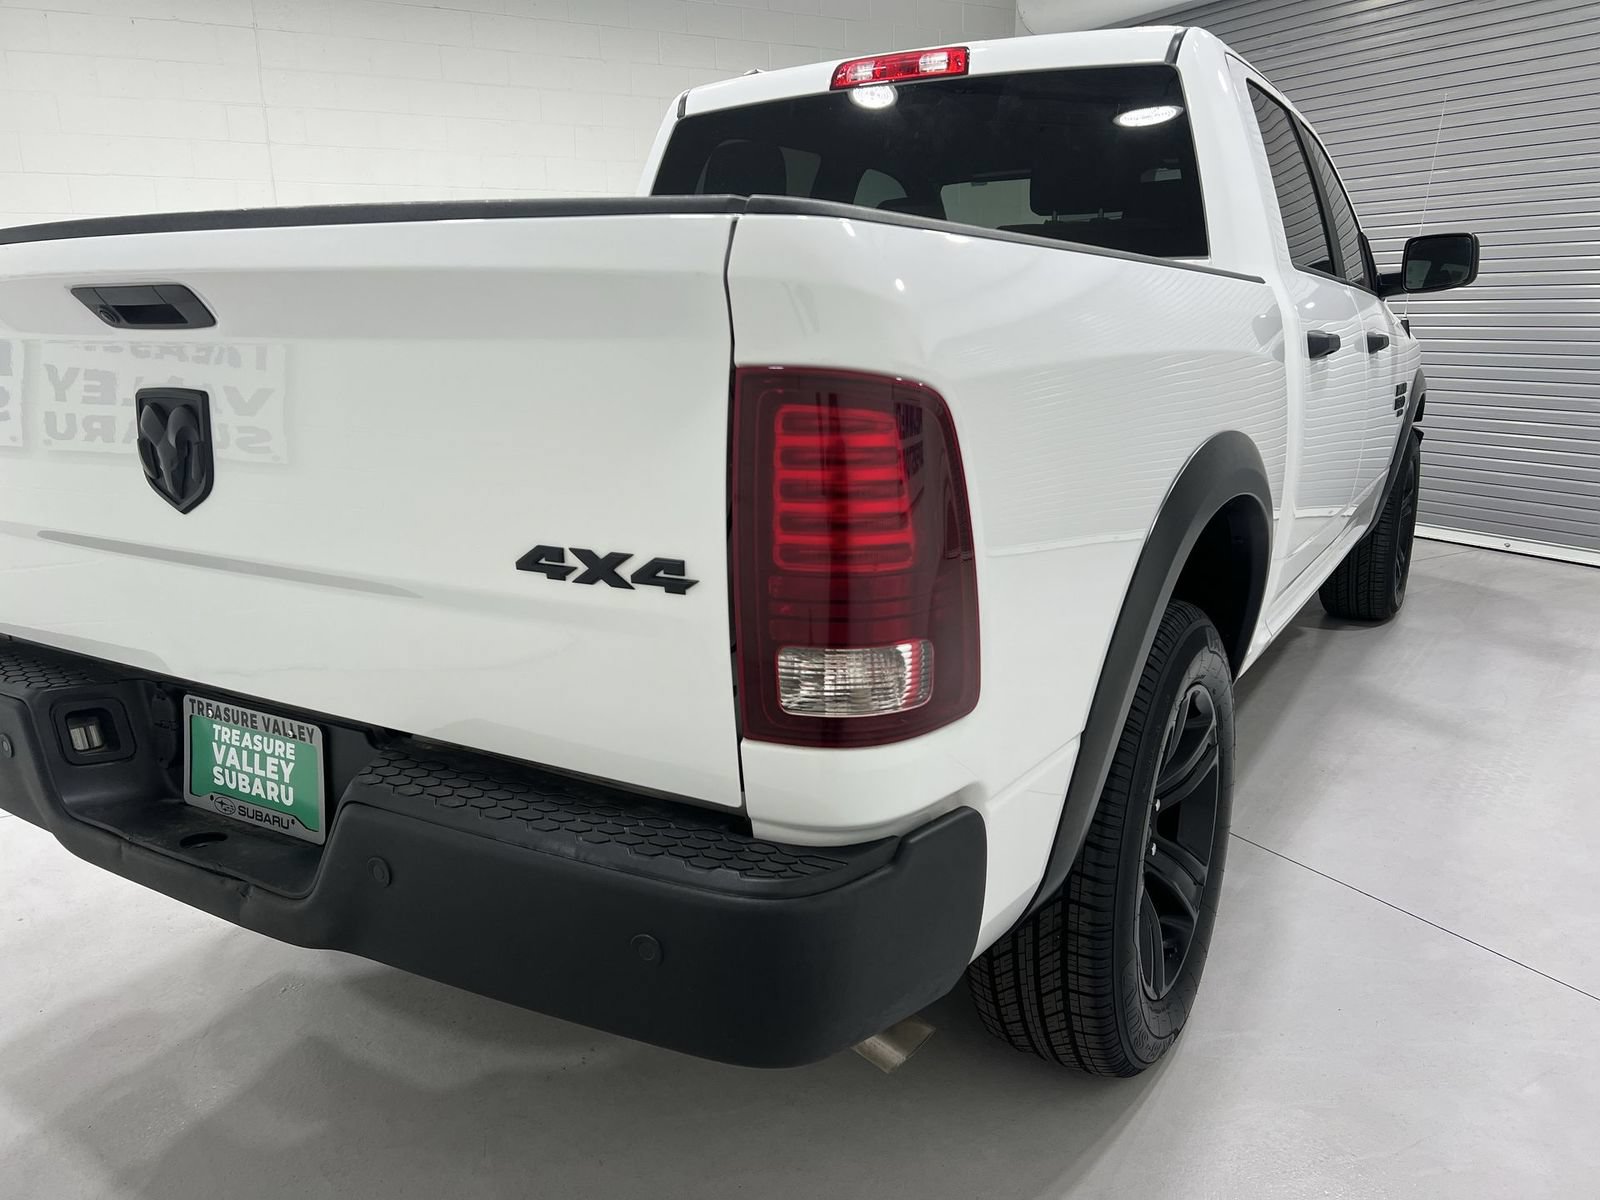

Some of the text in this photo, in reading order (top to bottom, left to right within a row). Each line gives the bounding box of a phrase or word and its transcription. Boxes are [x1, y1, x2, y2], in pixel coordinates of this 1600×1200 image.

[516, 545, 700, 595] 4X4
[188, 698, 315, 743] TREASURE VALLEY
[212, 724, 296, 760] TREASURE
[212, 742, 295, 784] VALLEY
[212, 766, 294, 806] SUBARU
[238, 805, 290, 829] SUBARU
